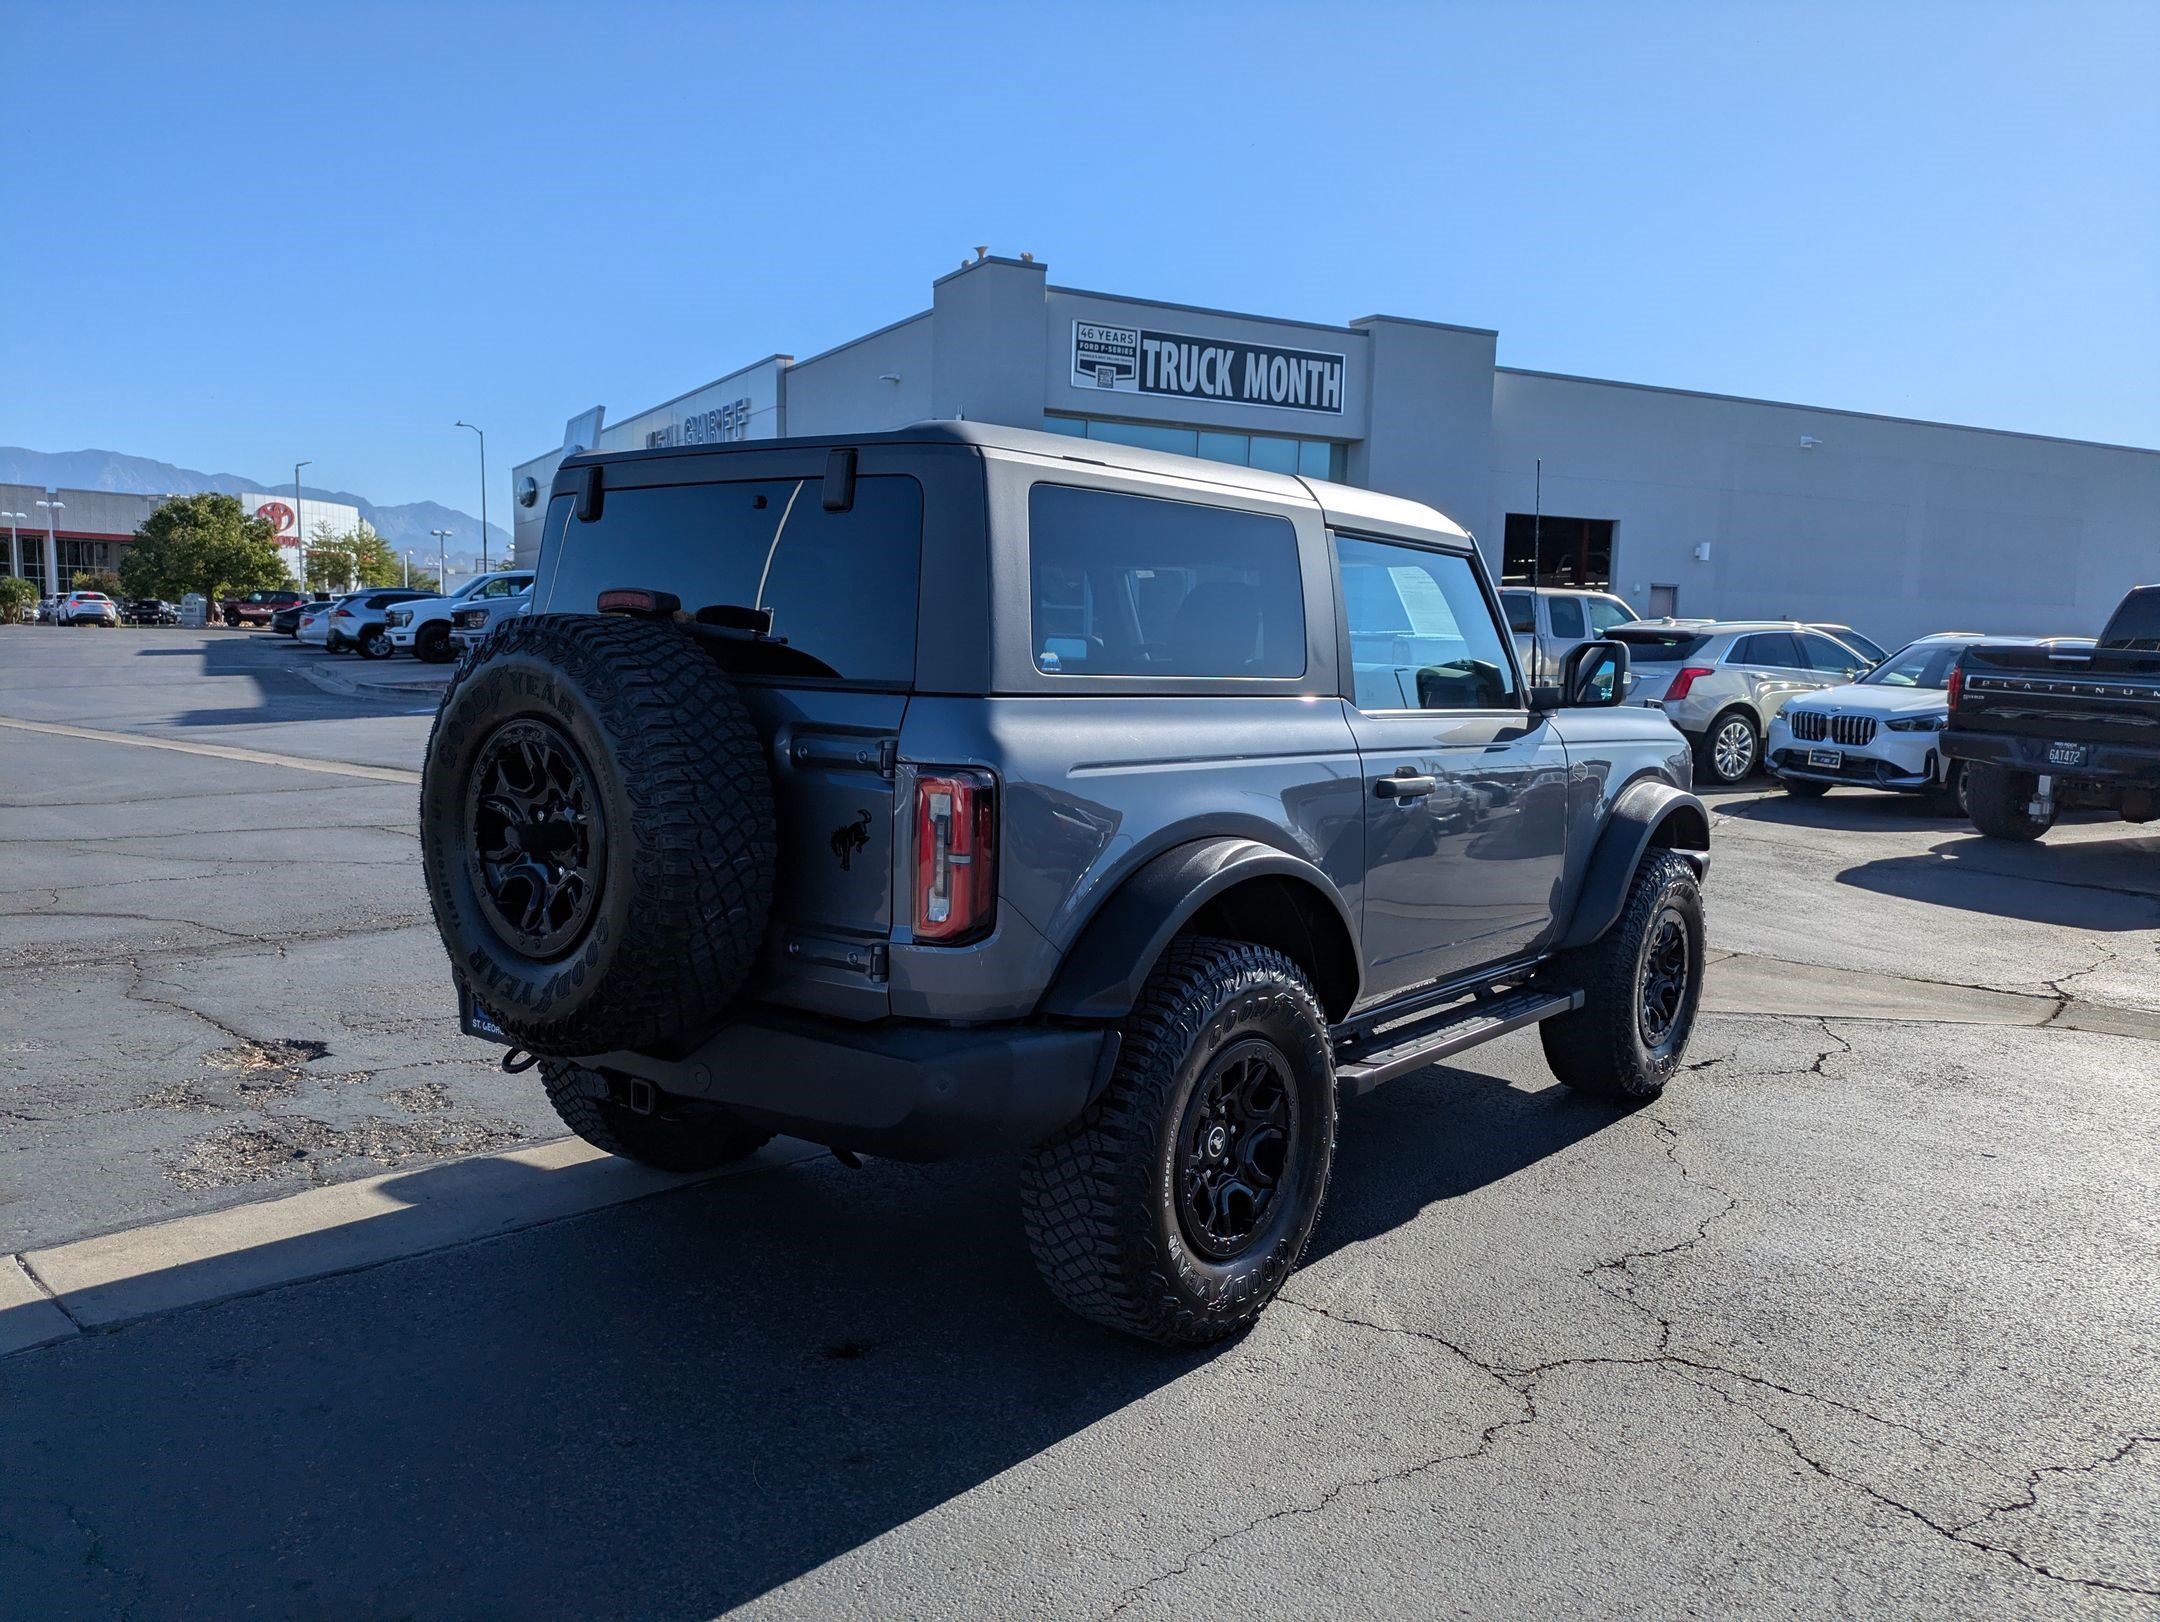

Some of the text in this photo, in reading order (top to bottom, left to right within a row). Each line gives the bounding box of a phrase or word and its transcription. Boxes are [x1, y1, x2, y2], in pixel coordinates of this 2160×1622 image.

[1080, 328, 1134, 345] 46 YEARS
[1079, 342, 1134, 355] FORD F-SERIES
[1143, 339, 1340, 408] TRUCK MONTH
[685, 398, 752, 445] GARFF
[2049, 748, 2080, 763] 6AT472
[472, 1018, 505, 1036] ST. GEOR
[1168, 1233, 1288, 1310] GOODYEAR
